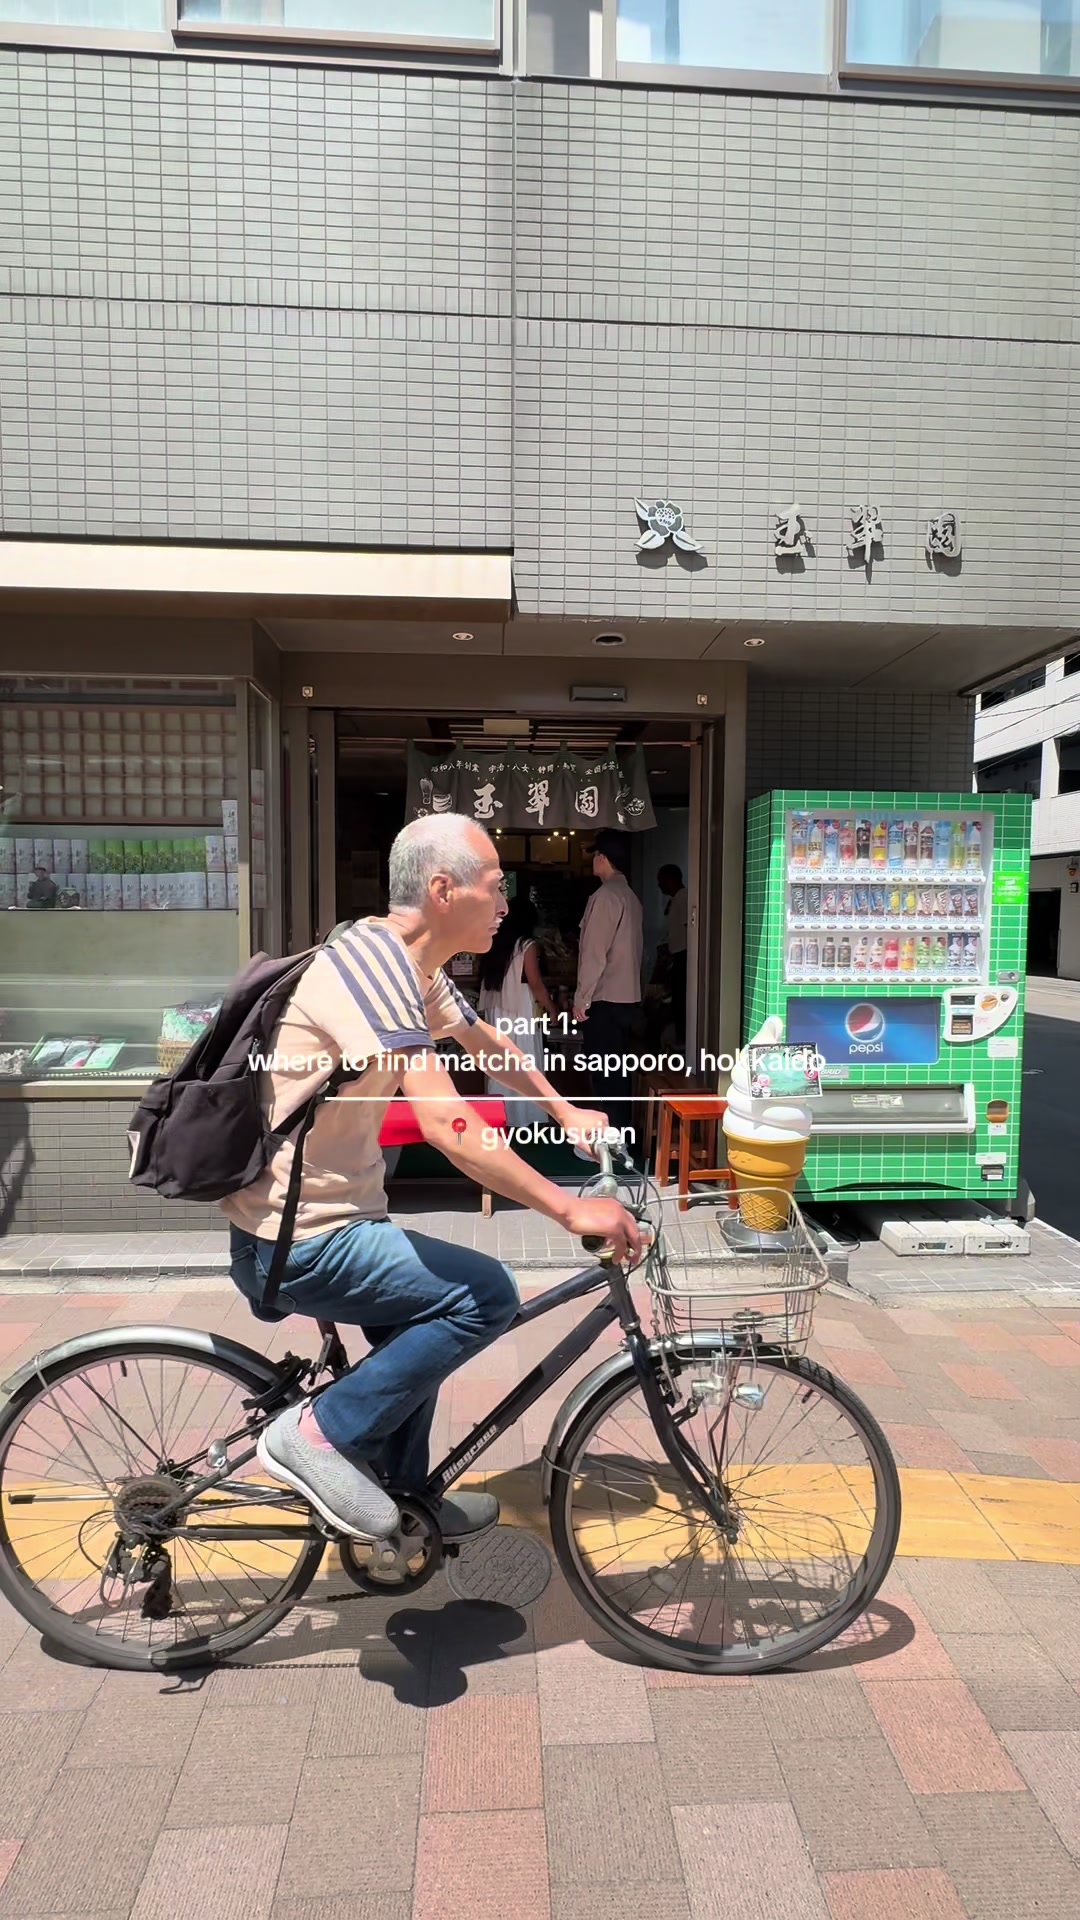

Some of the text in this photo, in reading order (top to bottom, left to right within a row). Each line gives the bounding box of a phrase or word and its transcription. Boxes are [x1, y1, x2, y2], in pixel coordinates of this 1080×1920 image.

[473, 779, 599, 826] 玉翠園
[848, 1043, 884, 1055] pepsi
